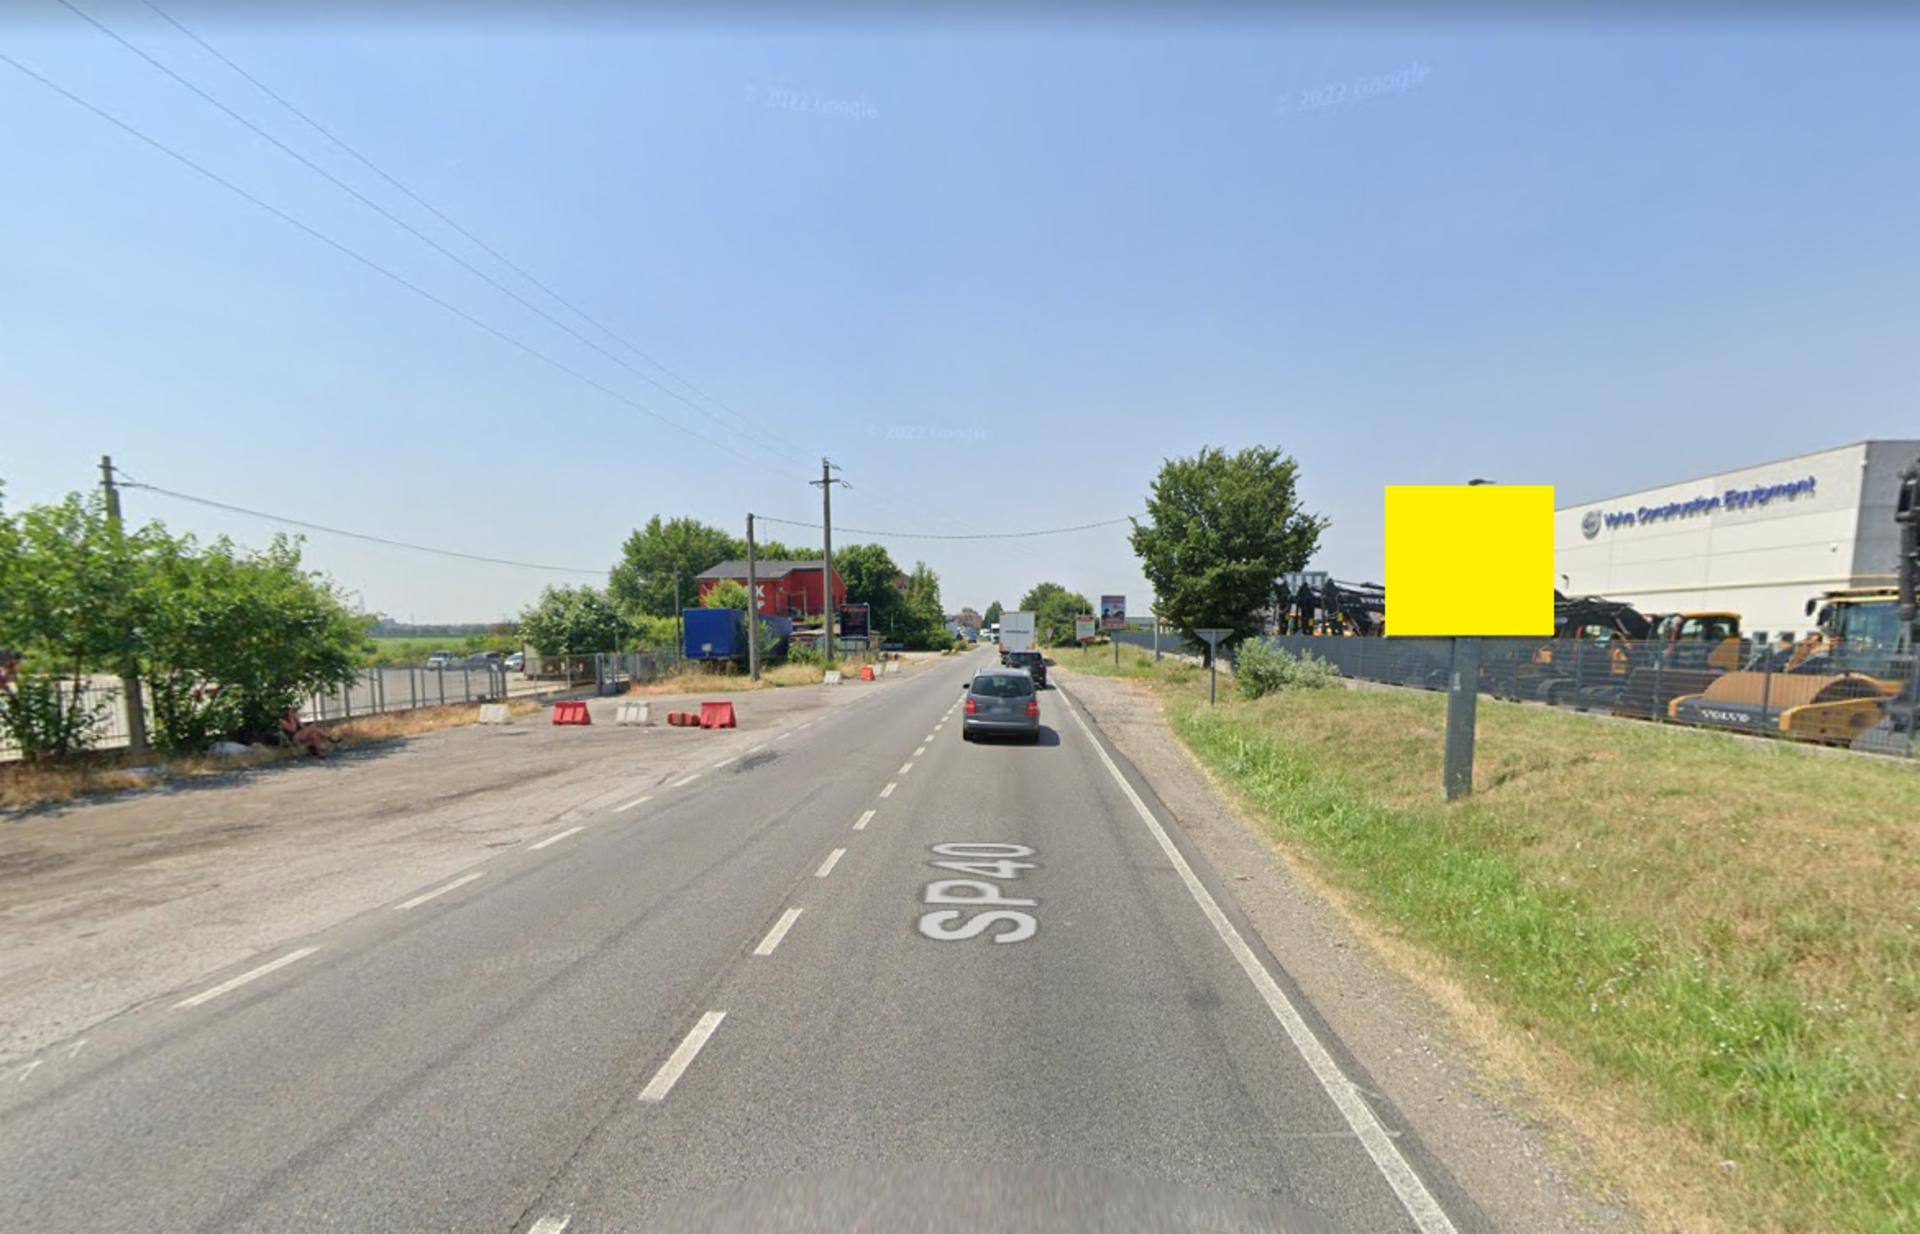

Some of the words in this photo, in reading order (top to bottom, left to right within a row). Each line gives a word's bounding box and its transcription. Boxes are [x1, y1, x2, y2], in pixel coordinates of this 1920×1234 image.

[1604, 512, 1636, 529] Volvo
[1638, 495, 1720, 523] Construction
[1723, 475, 1816, 509] Equipment
[1360, 597, 1385, 605] VOLV
